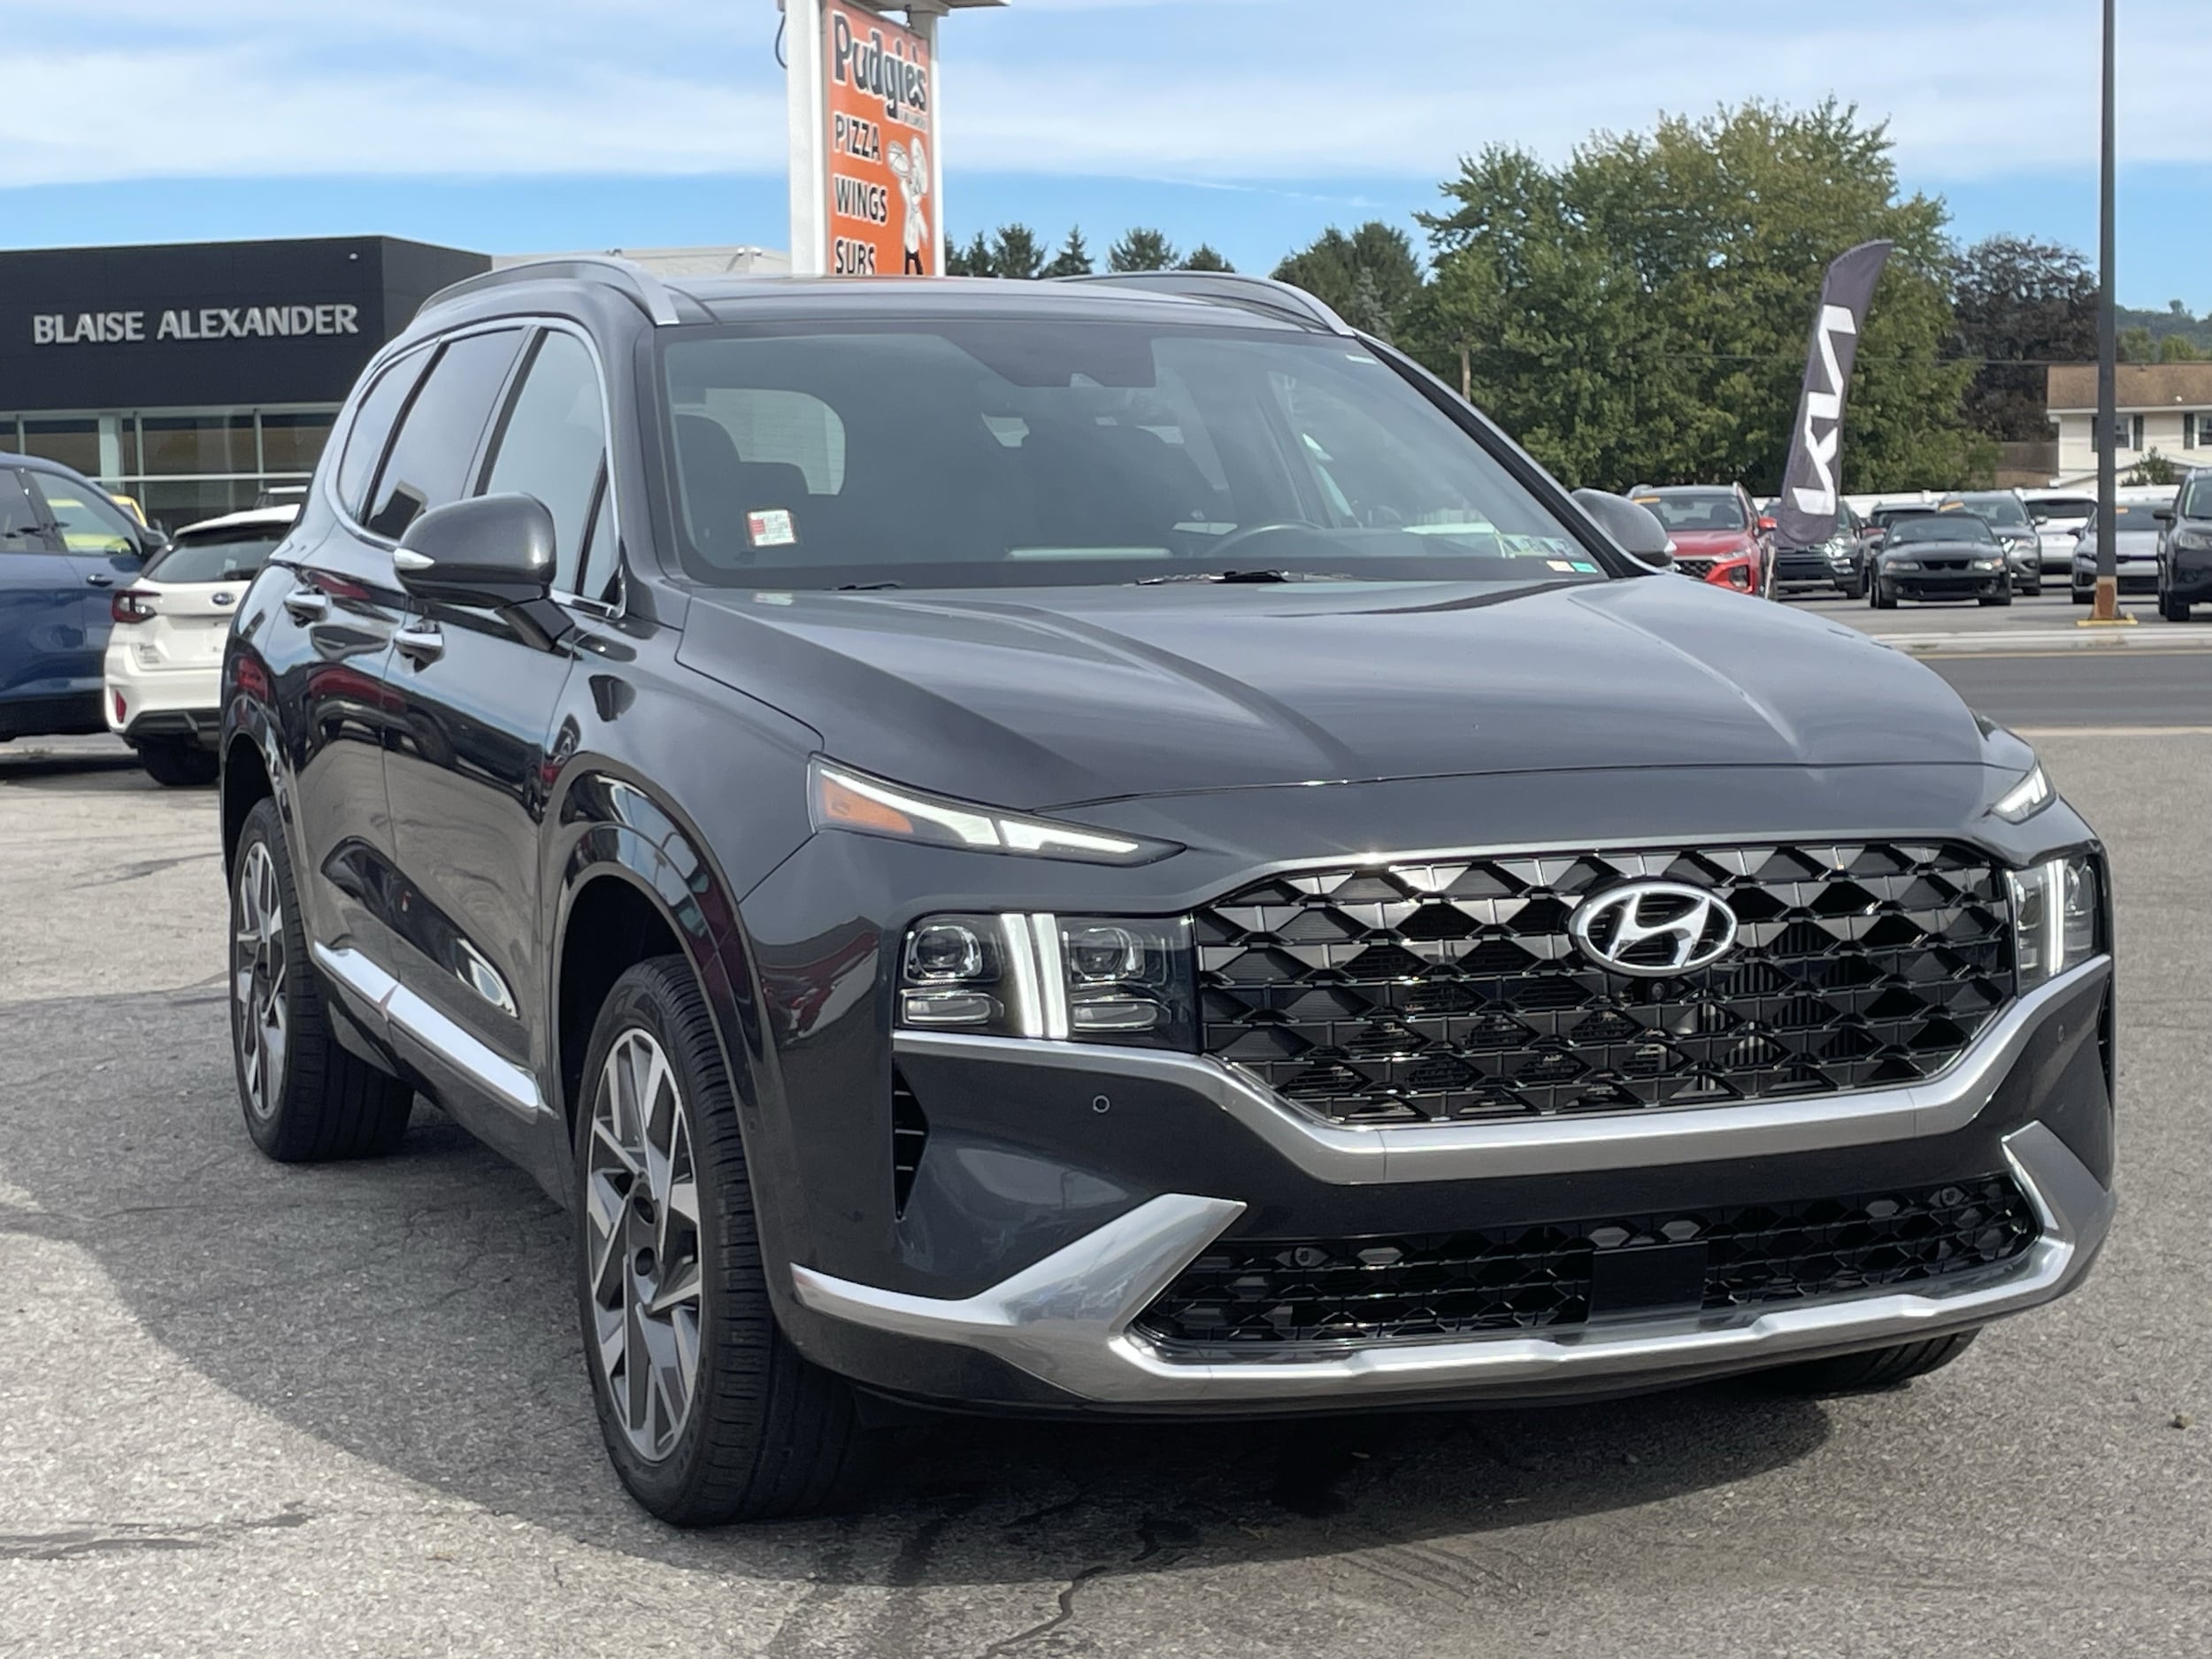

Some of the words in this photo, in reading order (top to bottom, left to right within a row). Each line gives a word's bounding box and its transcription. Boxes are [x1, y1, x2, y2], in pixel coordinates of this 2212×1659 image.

[834, 113, 882, 162] PIZZA
[834, 175, 887, 224] WINGS
[33, 311, 146, 344] BLAISE
[156, 303, 359, 341] ALEXANDER
